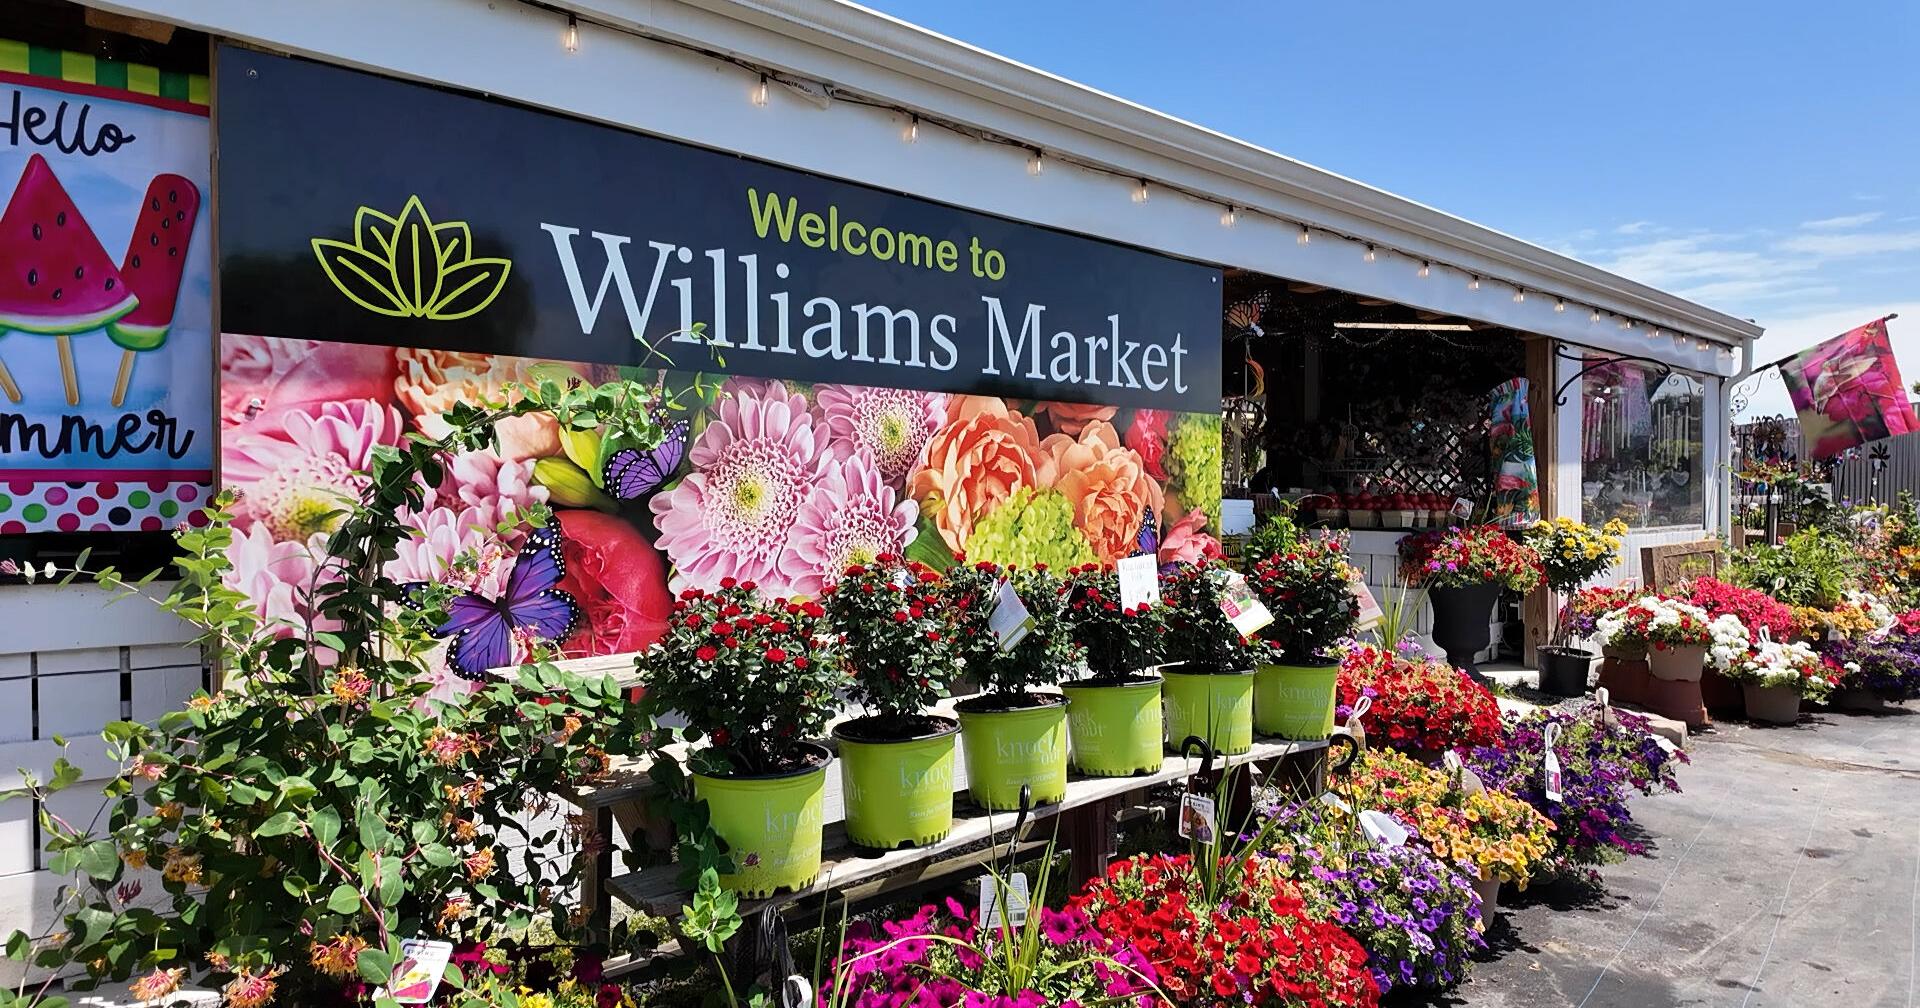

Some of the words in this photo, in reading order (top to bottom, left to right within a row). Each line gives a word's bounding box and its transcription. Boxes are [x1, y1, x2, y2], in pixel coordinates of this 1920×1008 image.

[0, 89, 136, 157] Hello
[747, 187, 959, 273] Welcome
[968, 236, 1007, 281] to
[540, 222, 959, 371] Williams
[981, 295, 1189, 394] Market
[0, 409, 195, 460] mmer
[996, 732, 1057, 758] knock
[766, 802, 822, 833] knoc
